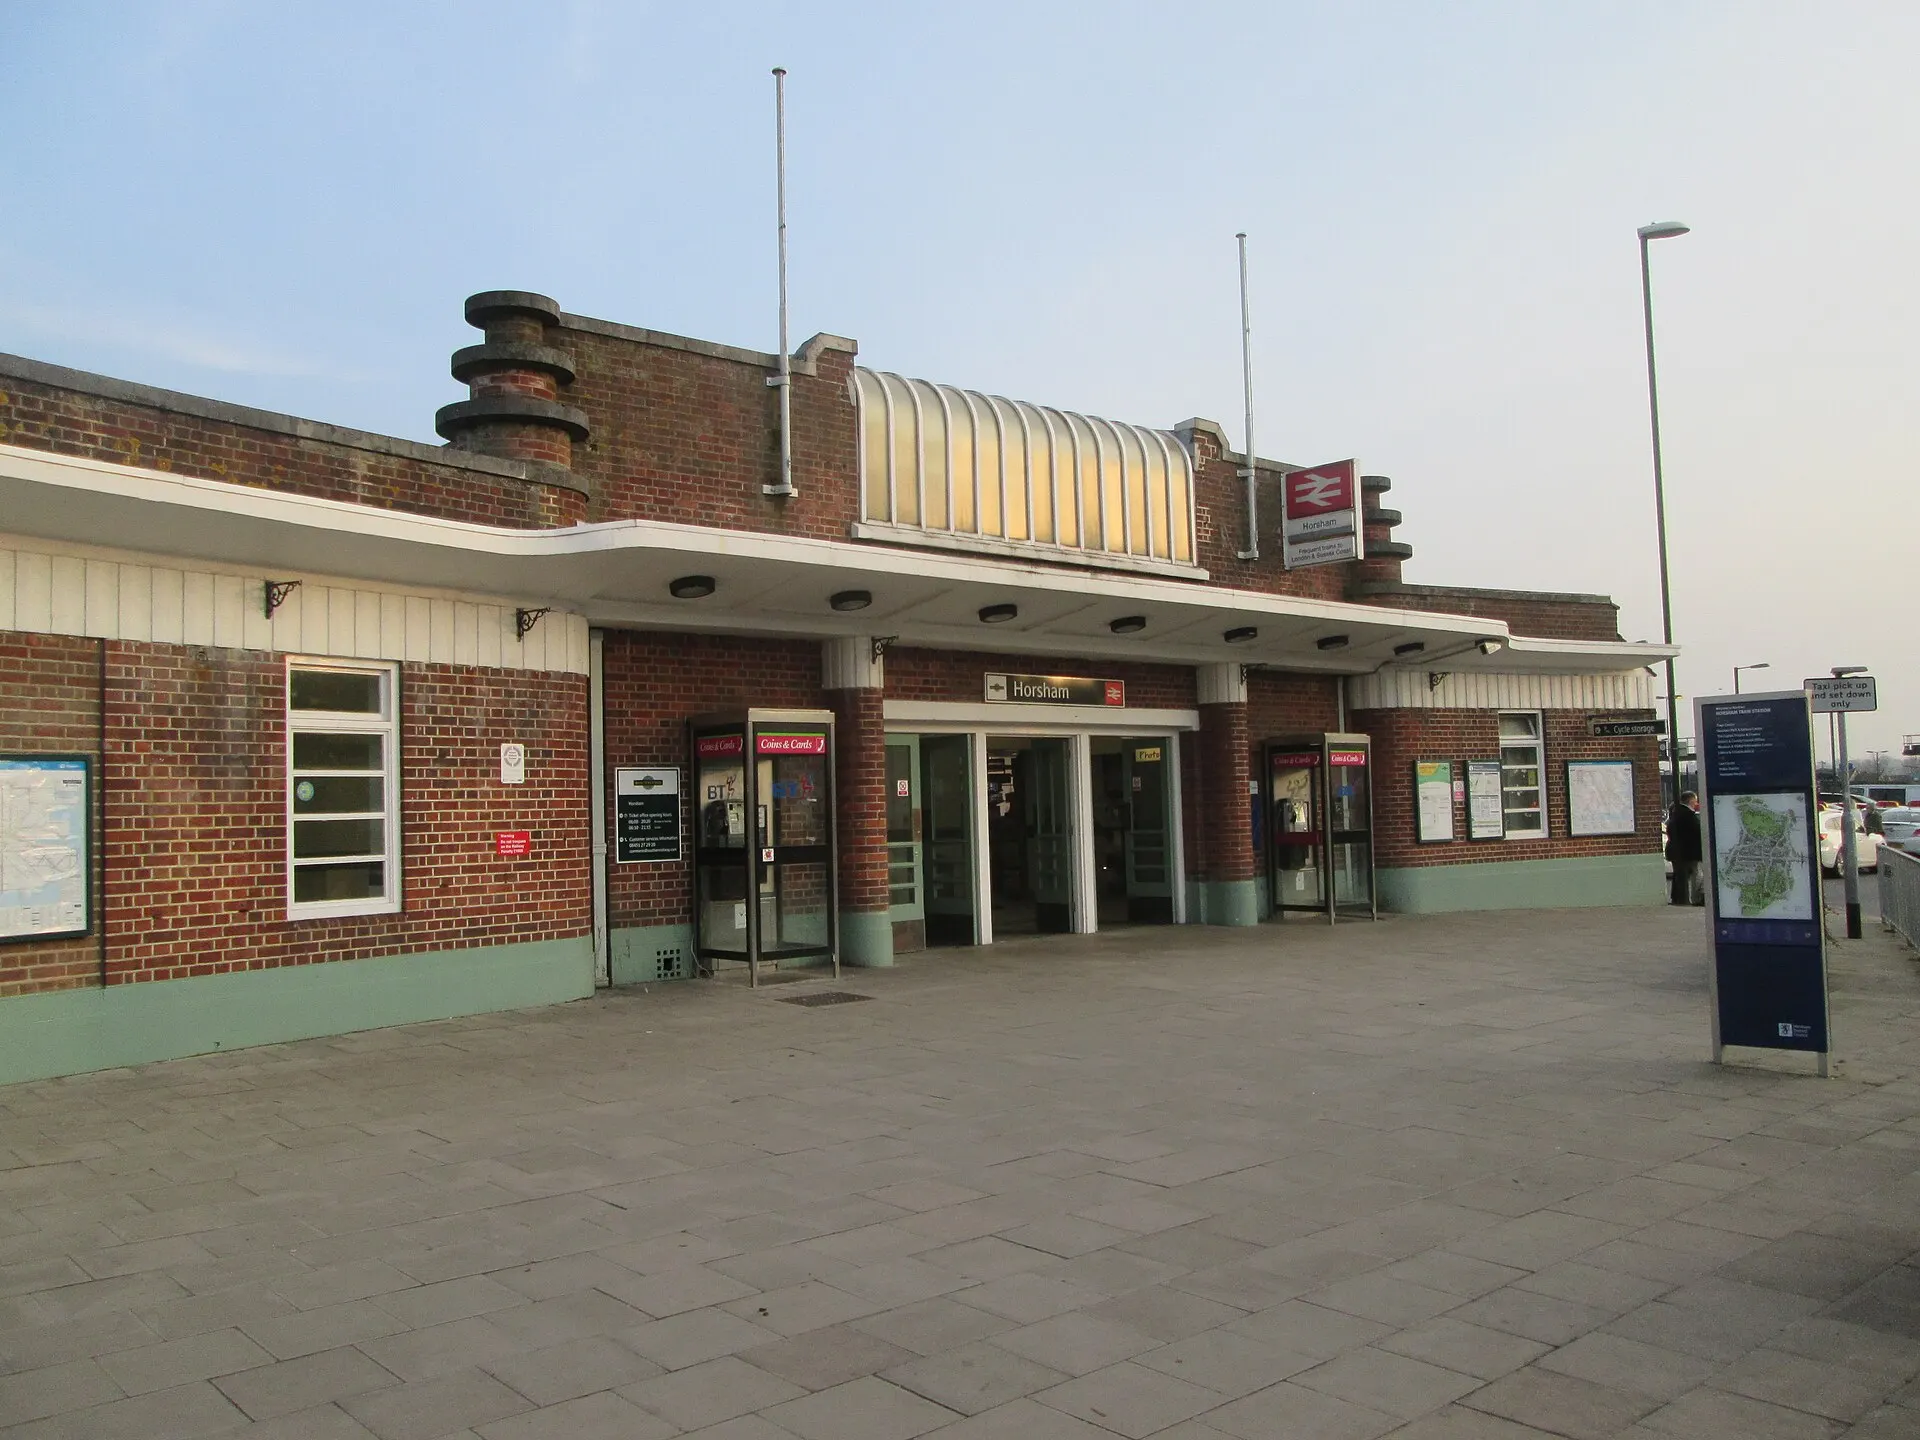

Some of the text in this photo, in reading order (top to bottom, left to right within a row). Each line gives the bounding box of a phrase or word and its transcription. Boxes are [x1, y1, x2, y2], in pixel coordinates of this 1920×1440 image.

[1302, 519, 1337, 530] Horsham
[1291, 554, 1310, 562] London
[1013, 680, 1069, 699] Horsham
[1833, 681, 1853, 691] pick
[1856, 682, 1867, 690] up
[1829, 691, 1843, 699] set
[1831, 700, 1850, 708] only
[1613, 725, 1654, 734] Cycle storage
[700, 742, 714, 751] Coins
[719, 740, 734, 750] Cards
[760, 739, 813, 749] Coins & Cards
[1139, 751, 1159, 759] Photo
[707, 785, 725, 800] BT
